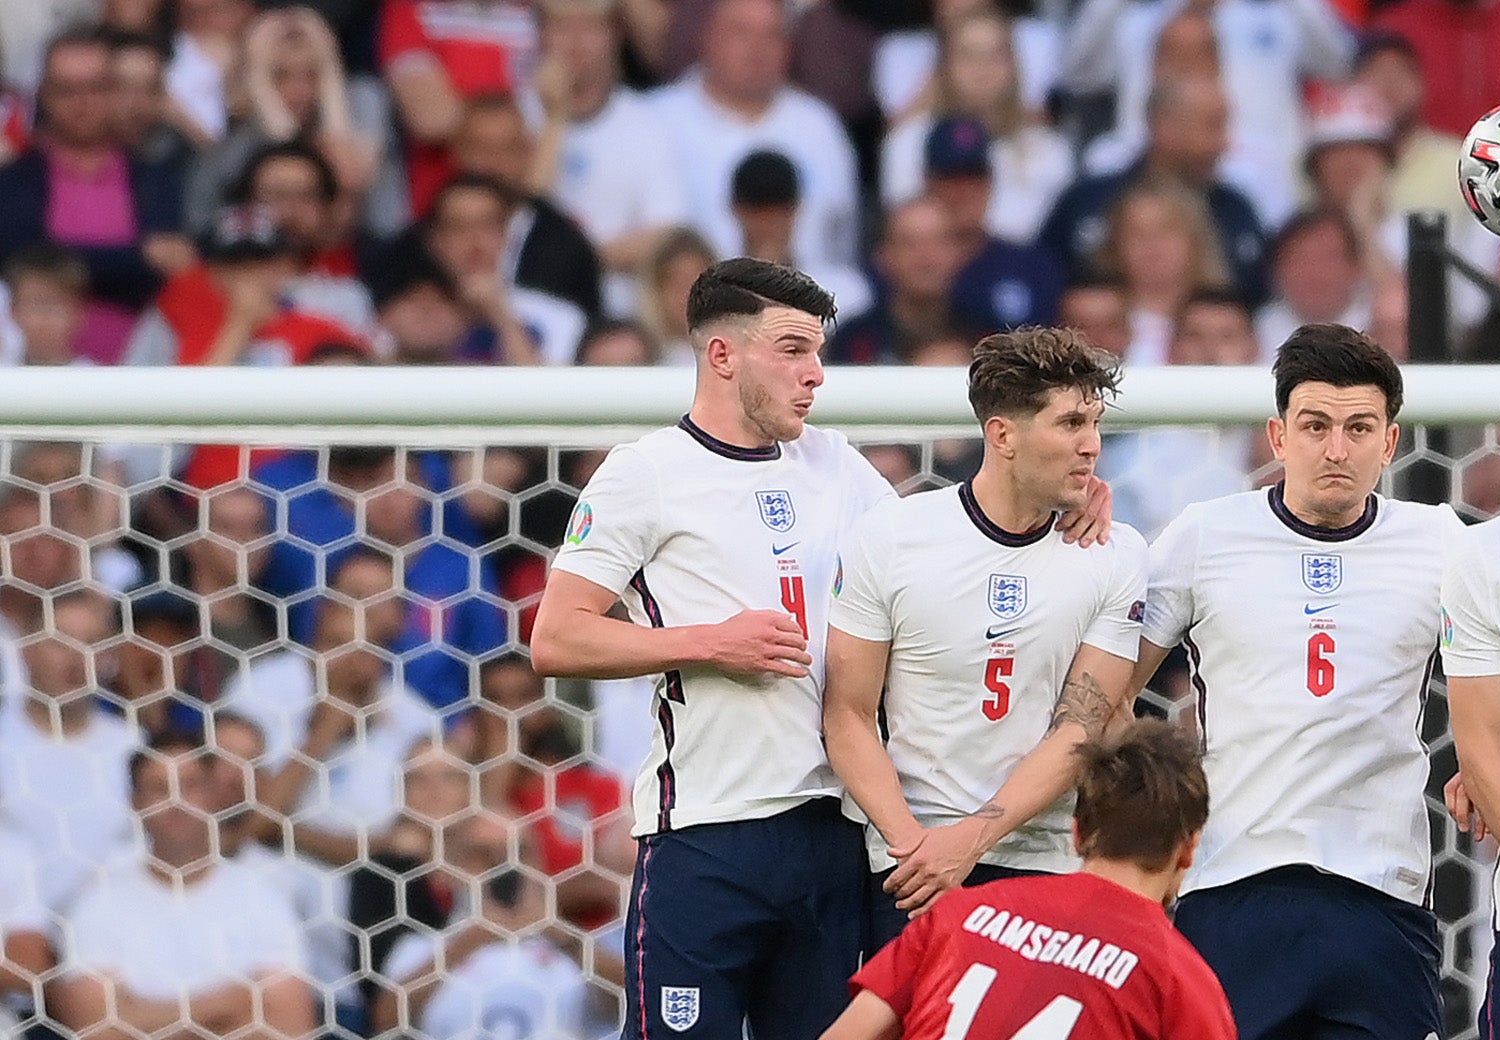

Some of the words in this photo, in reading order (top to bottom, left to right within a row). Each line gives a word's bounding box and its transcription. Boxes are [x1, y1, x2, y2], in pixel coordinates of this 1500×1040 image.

[779, 575, 809, 641] 4
[981, 657, 1015, 722] 5
[1307, 631, 1336, 698] 6
[962, 904, 1140, 990] DAMSGAARD
